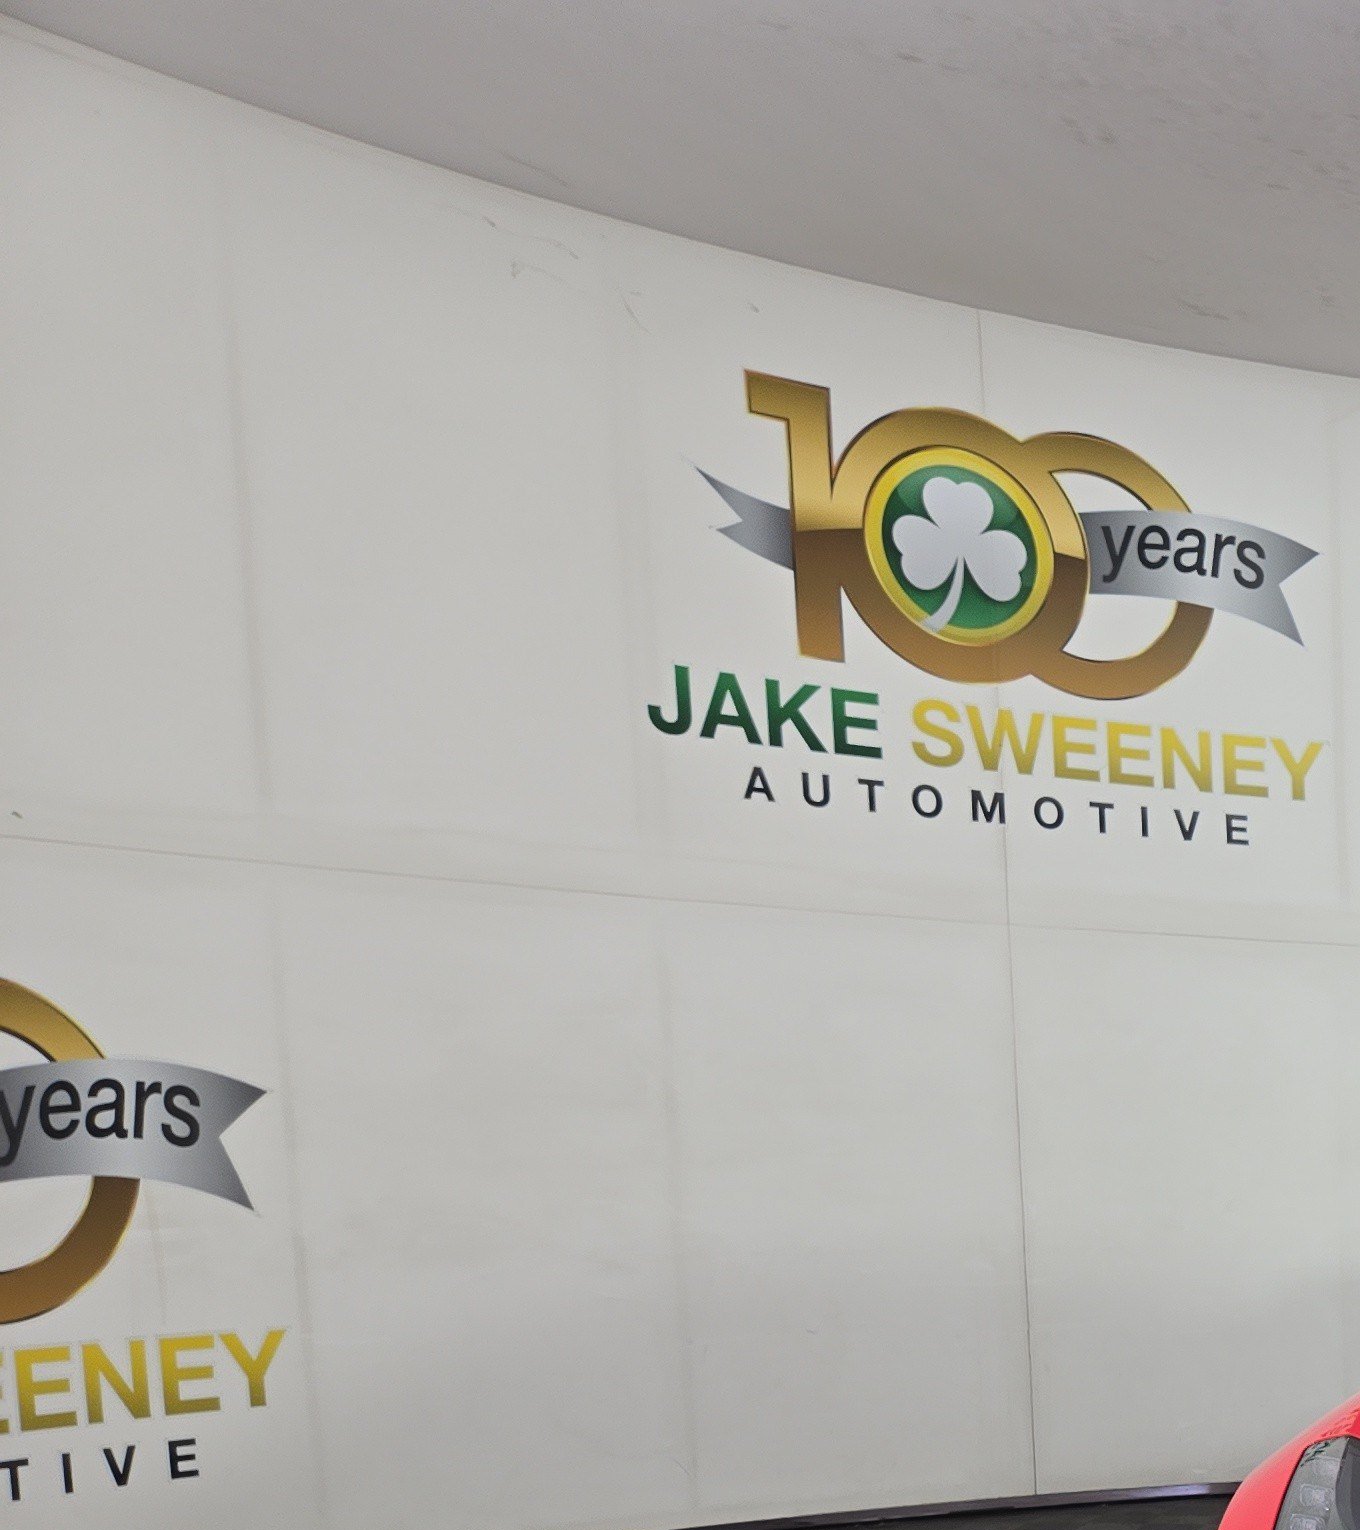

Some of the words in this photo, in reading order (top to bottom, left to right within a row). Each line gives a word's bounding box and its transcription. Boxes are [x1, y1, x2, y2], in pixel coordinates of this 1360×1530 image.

[1101, 520, 1267, 590] years
[647, 663, 884, 760] JAKE
[909, 698, 1325, 802] SWEENEY
[743, 766, 1251, 847] AUTOMOTIVE
[0, 1076, 202, 1167] years
[0, 1328, 287, 1435] ENEY
